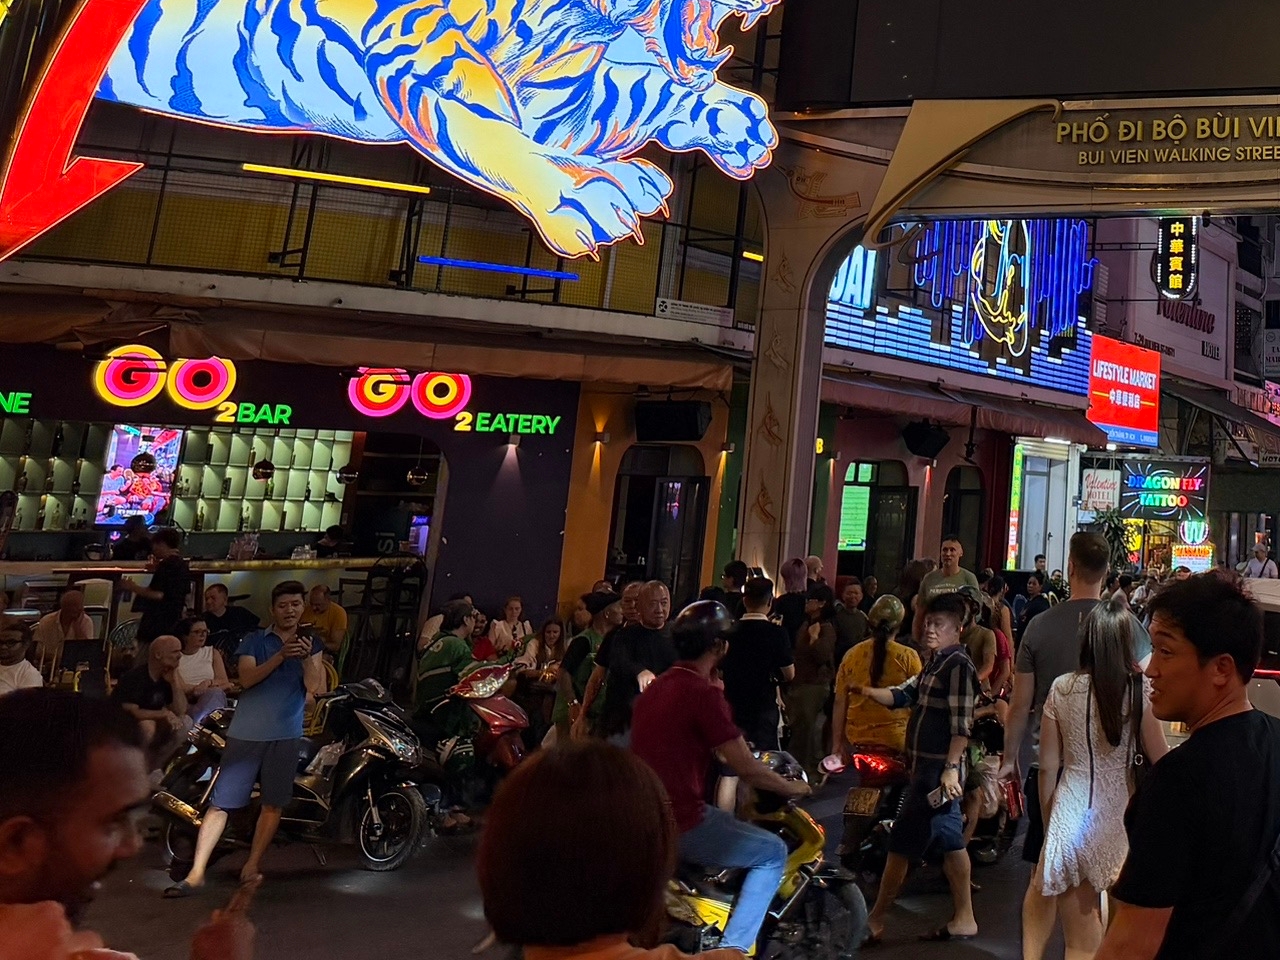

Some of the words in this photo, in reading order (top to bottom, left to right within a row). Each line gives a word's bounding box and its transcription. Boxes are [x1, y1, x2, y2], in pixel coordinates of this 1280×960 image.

[1056, 112, 1110, 144] PHỐ
[1118, 120, 1144, 142] ĐI
[1152, 113, 1188, 145] BỘ
[1196, 111, 1240, 140] BÙI
[1078, 150, 1105, 166] BUI
[1110, 148, 1149, 164] VIEN
[1154, 146, 1231, 163] WALKING
[1168, 221, 1185, 290] 中華賓館
[95, 344, 237, 411] GO
[236, 402, 293, 425] BAR
[1092, 359, 1129, 384] LIFESTYLE
[1129, 368, 1157, 390] MARKET
[475, 412, 562, 435] EATERY
[1127, 475, 1180, 490] DRAGON
[1182, 477, 1203, 491] FLY
[1087, 490, 1110, 500] HOTEL
[1140, 493, 1189, 508] TATTOO
